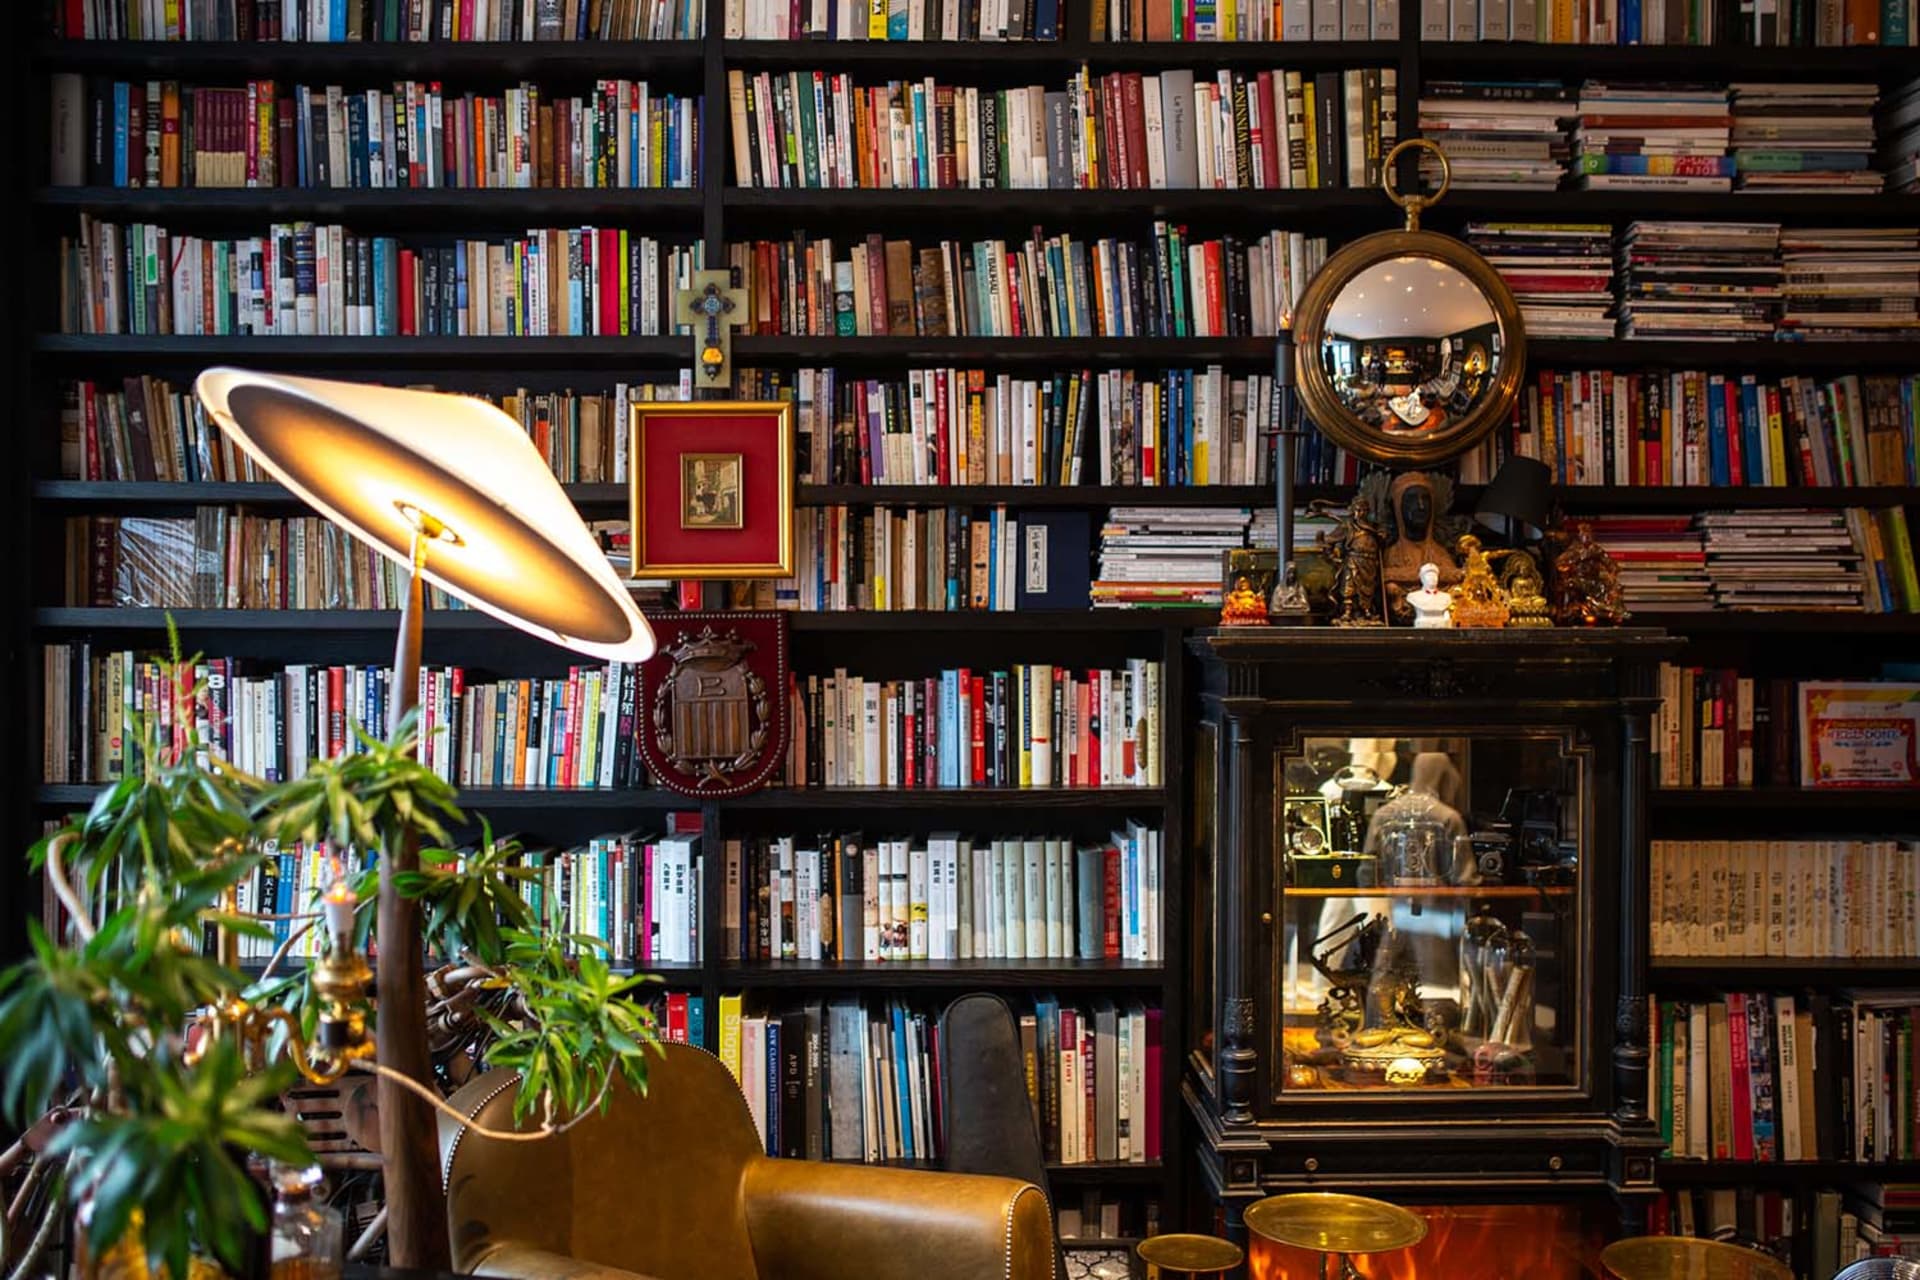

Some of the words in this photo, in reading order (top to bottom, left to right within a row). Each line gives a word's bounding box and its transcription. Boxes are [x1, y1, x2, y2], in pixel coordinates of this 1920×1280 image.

[984, 98, 996, 124] BOOK
[1233, 84, 1249, 145] WINNING
[985, 125, 996, 136] OF
[985, 138, 997, 174] HOUSES
[769, 1028, 777, 1044] NEW
[1675, 1103, 1686, 1137] work
